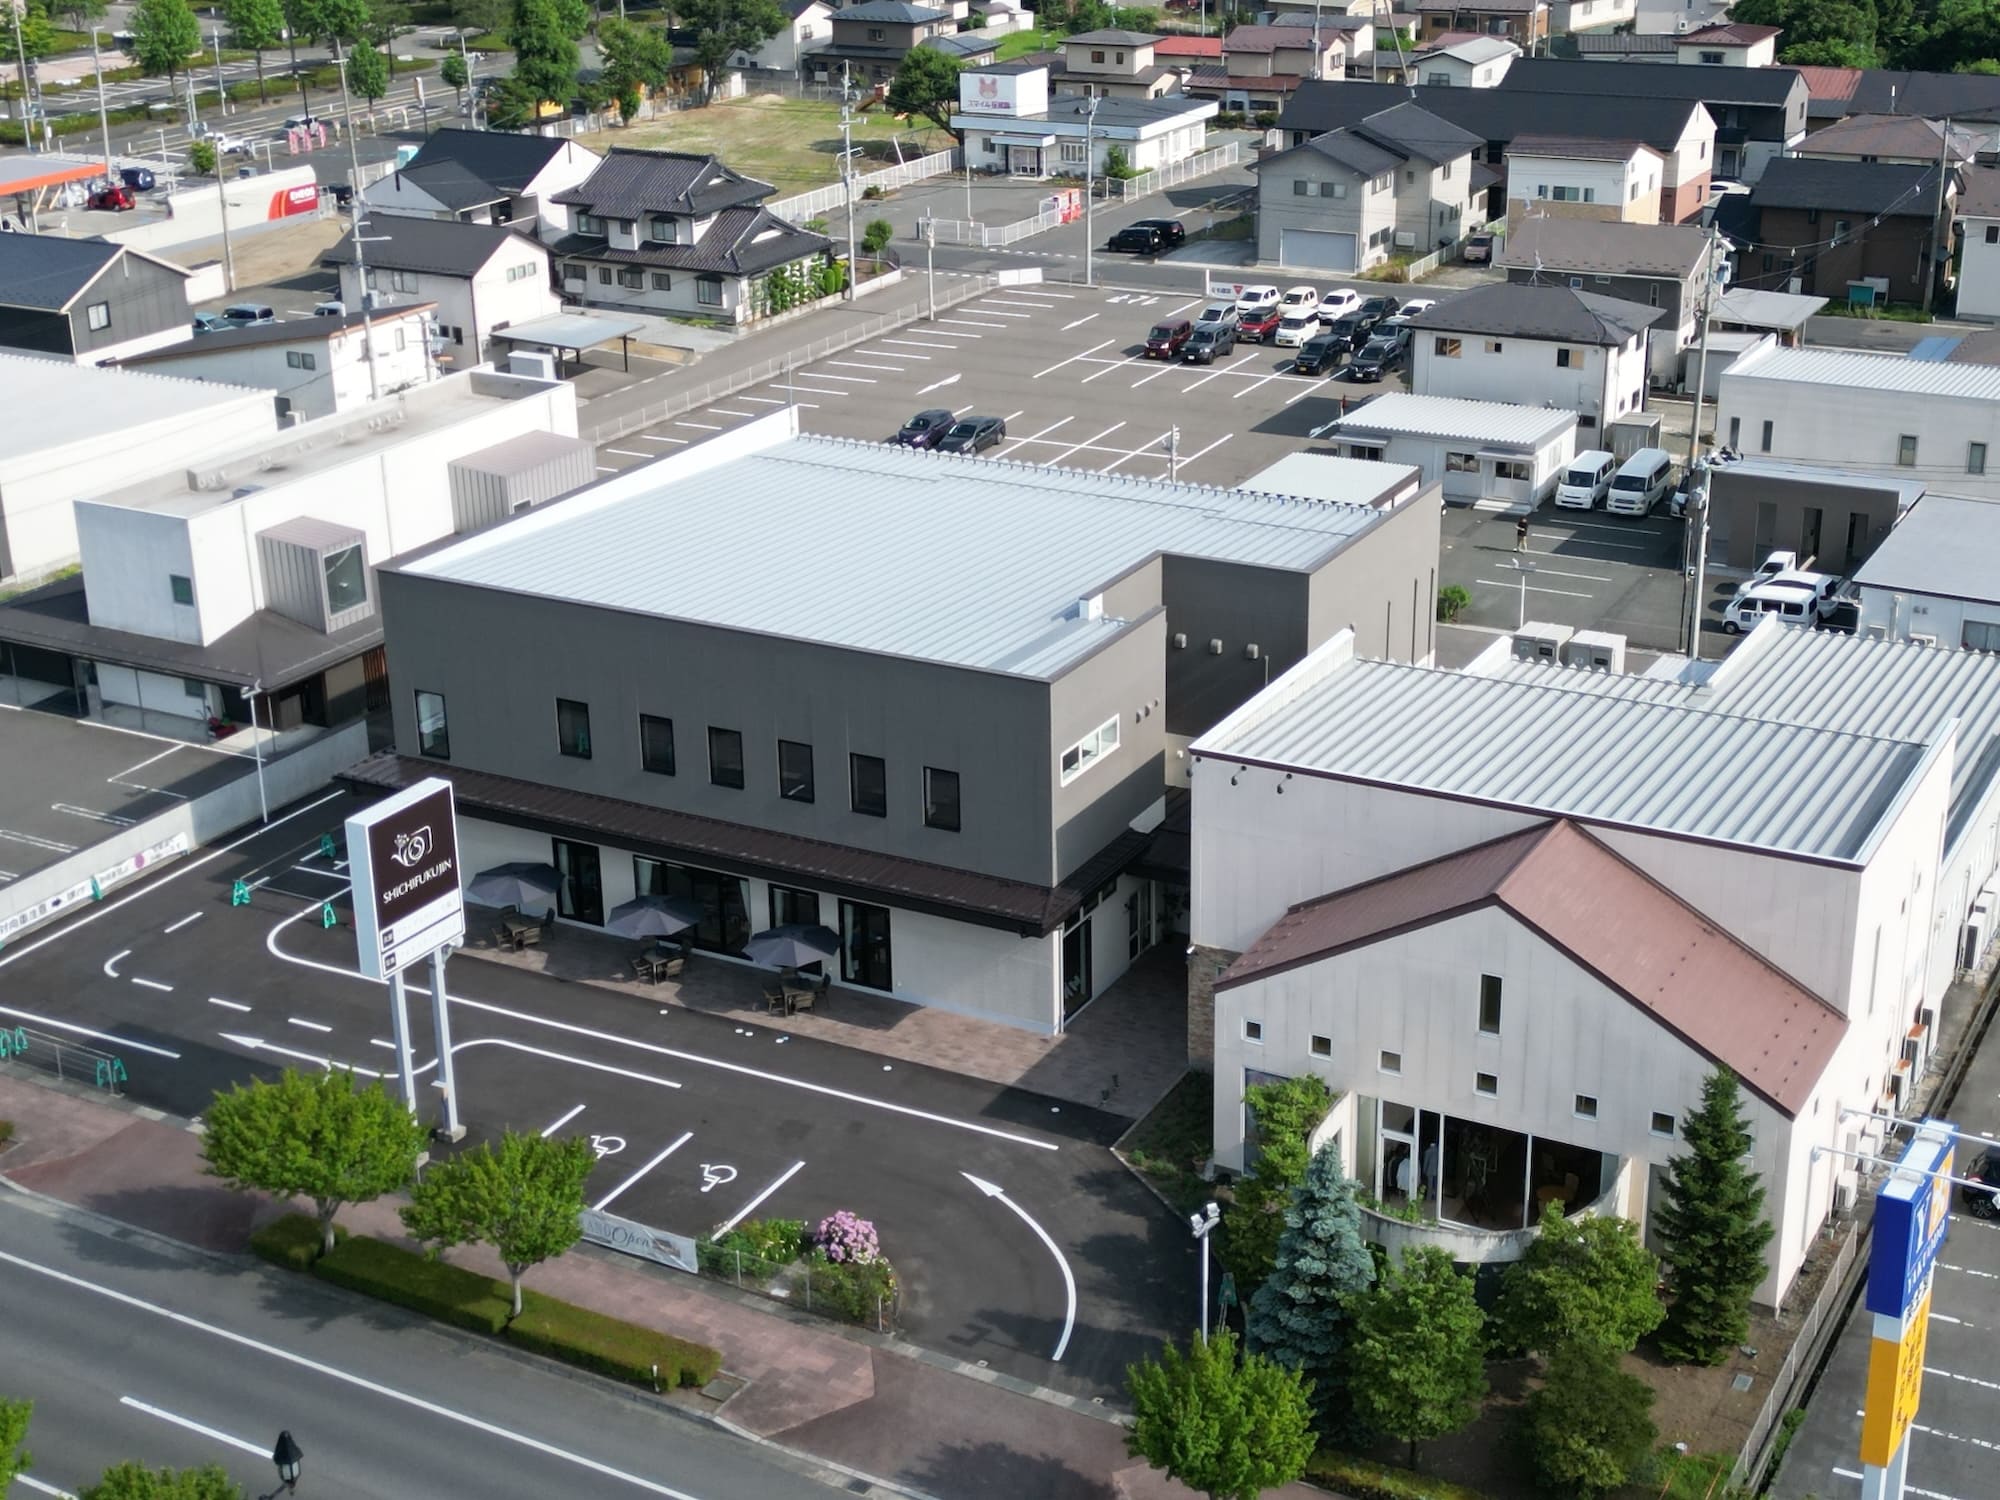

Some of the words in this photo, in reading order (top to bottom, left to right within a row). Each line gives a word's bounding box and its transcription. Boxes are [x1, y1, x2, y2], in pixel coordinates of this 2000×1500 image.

[290, 186, 315, 201] ENEOS
[383, 857, 452, 904] SHICHIFUKUJIN
[611, 1226, 650, 1248] Open
